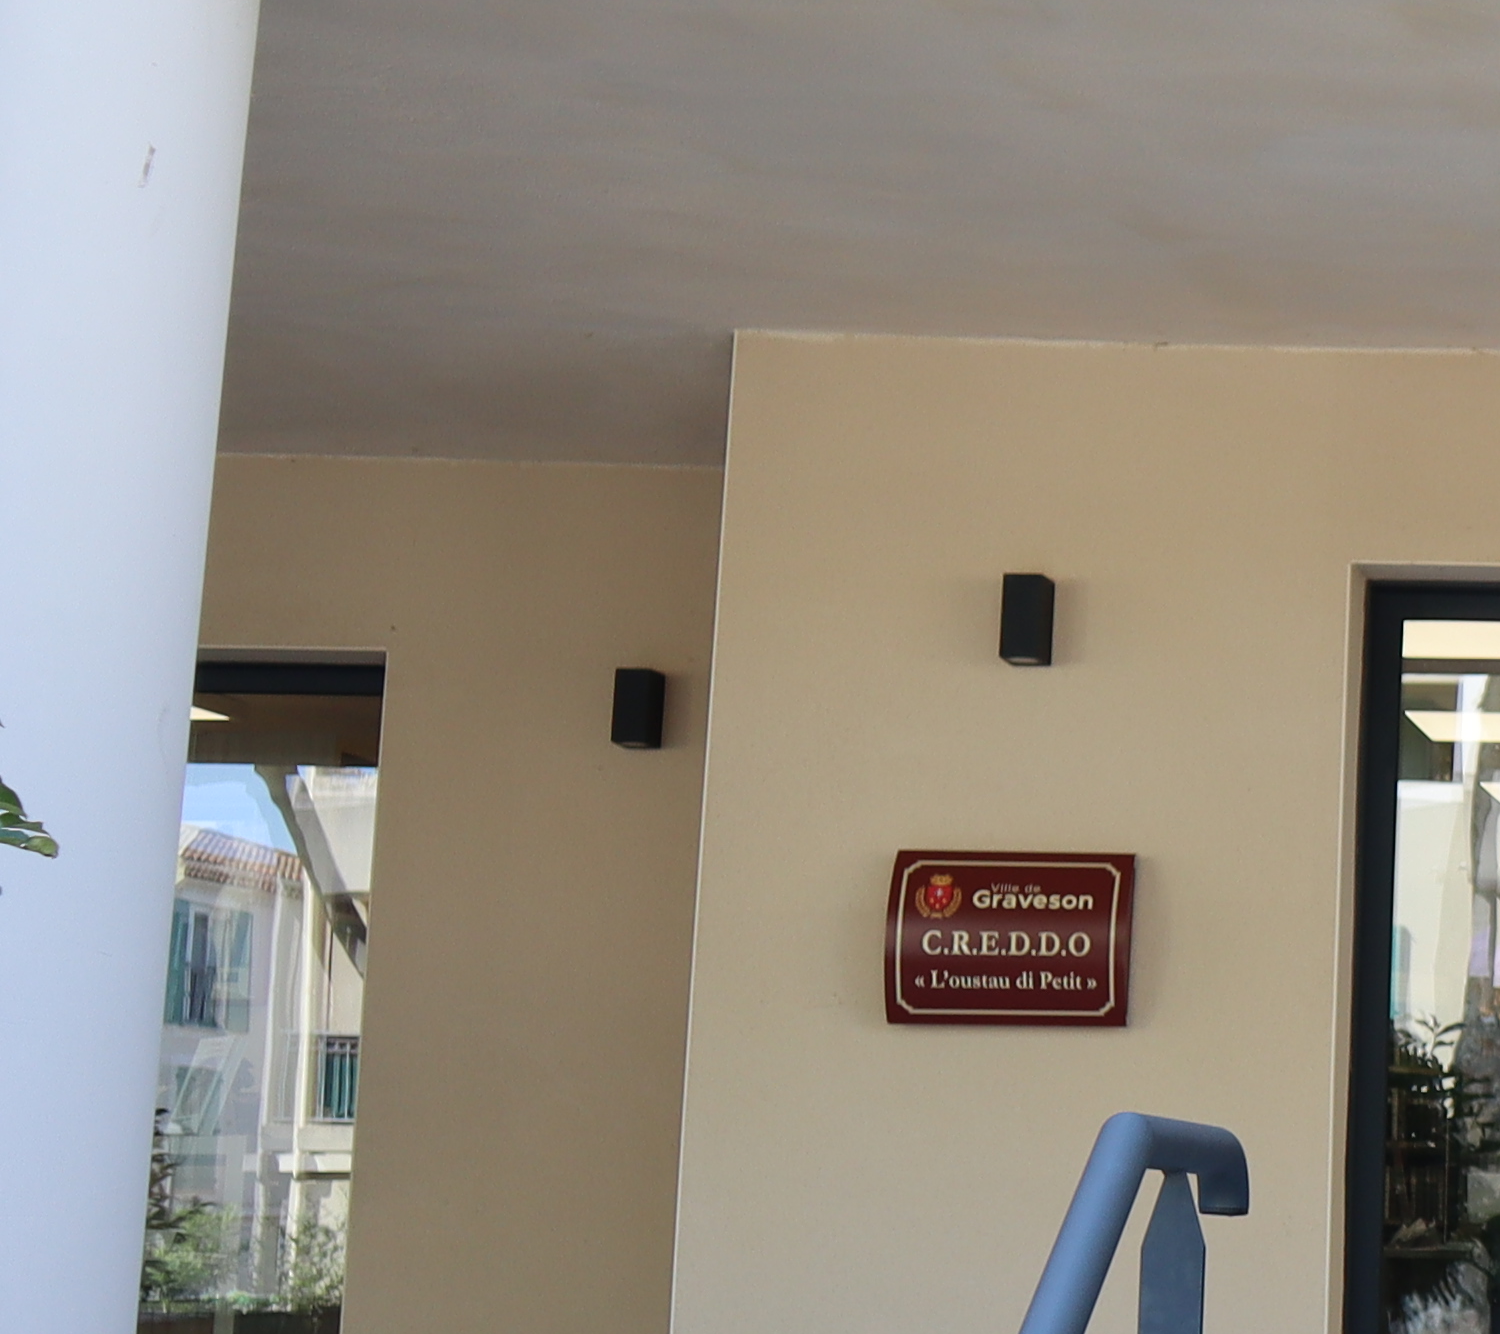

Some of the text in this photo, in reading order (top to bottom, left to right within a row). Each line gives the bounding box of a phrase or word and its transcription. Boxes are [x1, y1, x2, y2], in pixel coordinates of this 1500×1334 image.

[990, 882, 1042, 894] Ville de
[971, 889, 1094, 911] Graveson
[921, 929, 1092, 958] C.R.E.D.D.O
[930, 969, 1011, 990] L'oustau
[1015, 970, 1035, 990] di
[1039, 971, 1083, 991] Petit
